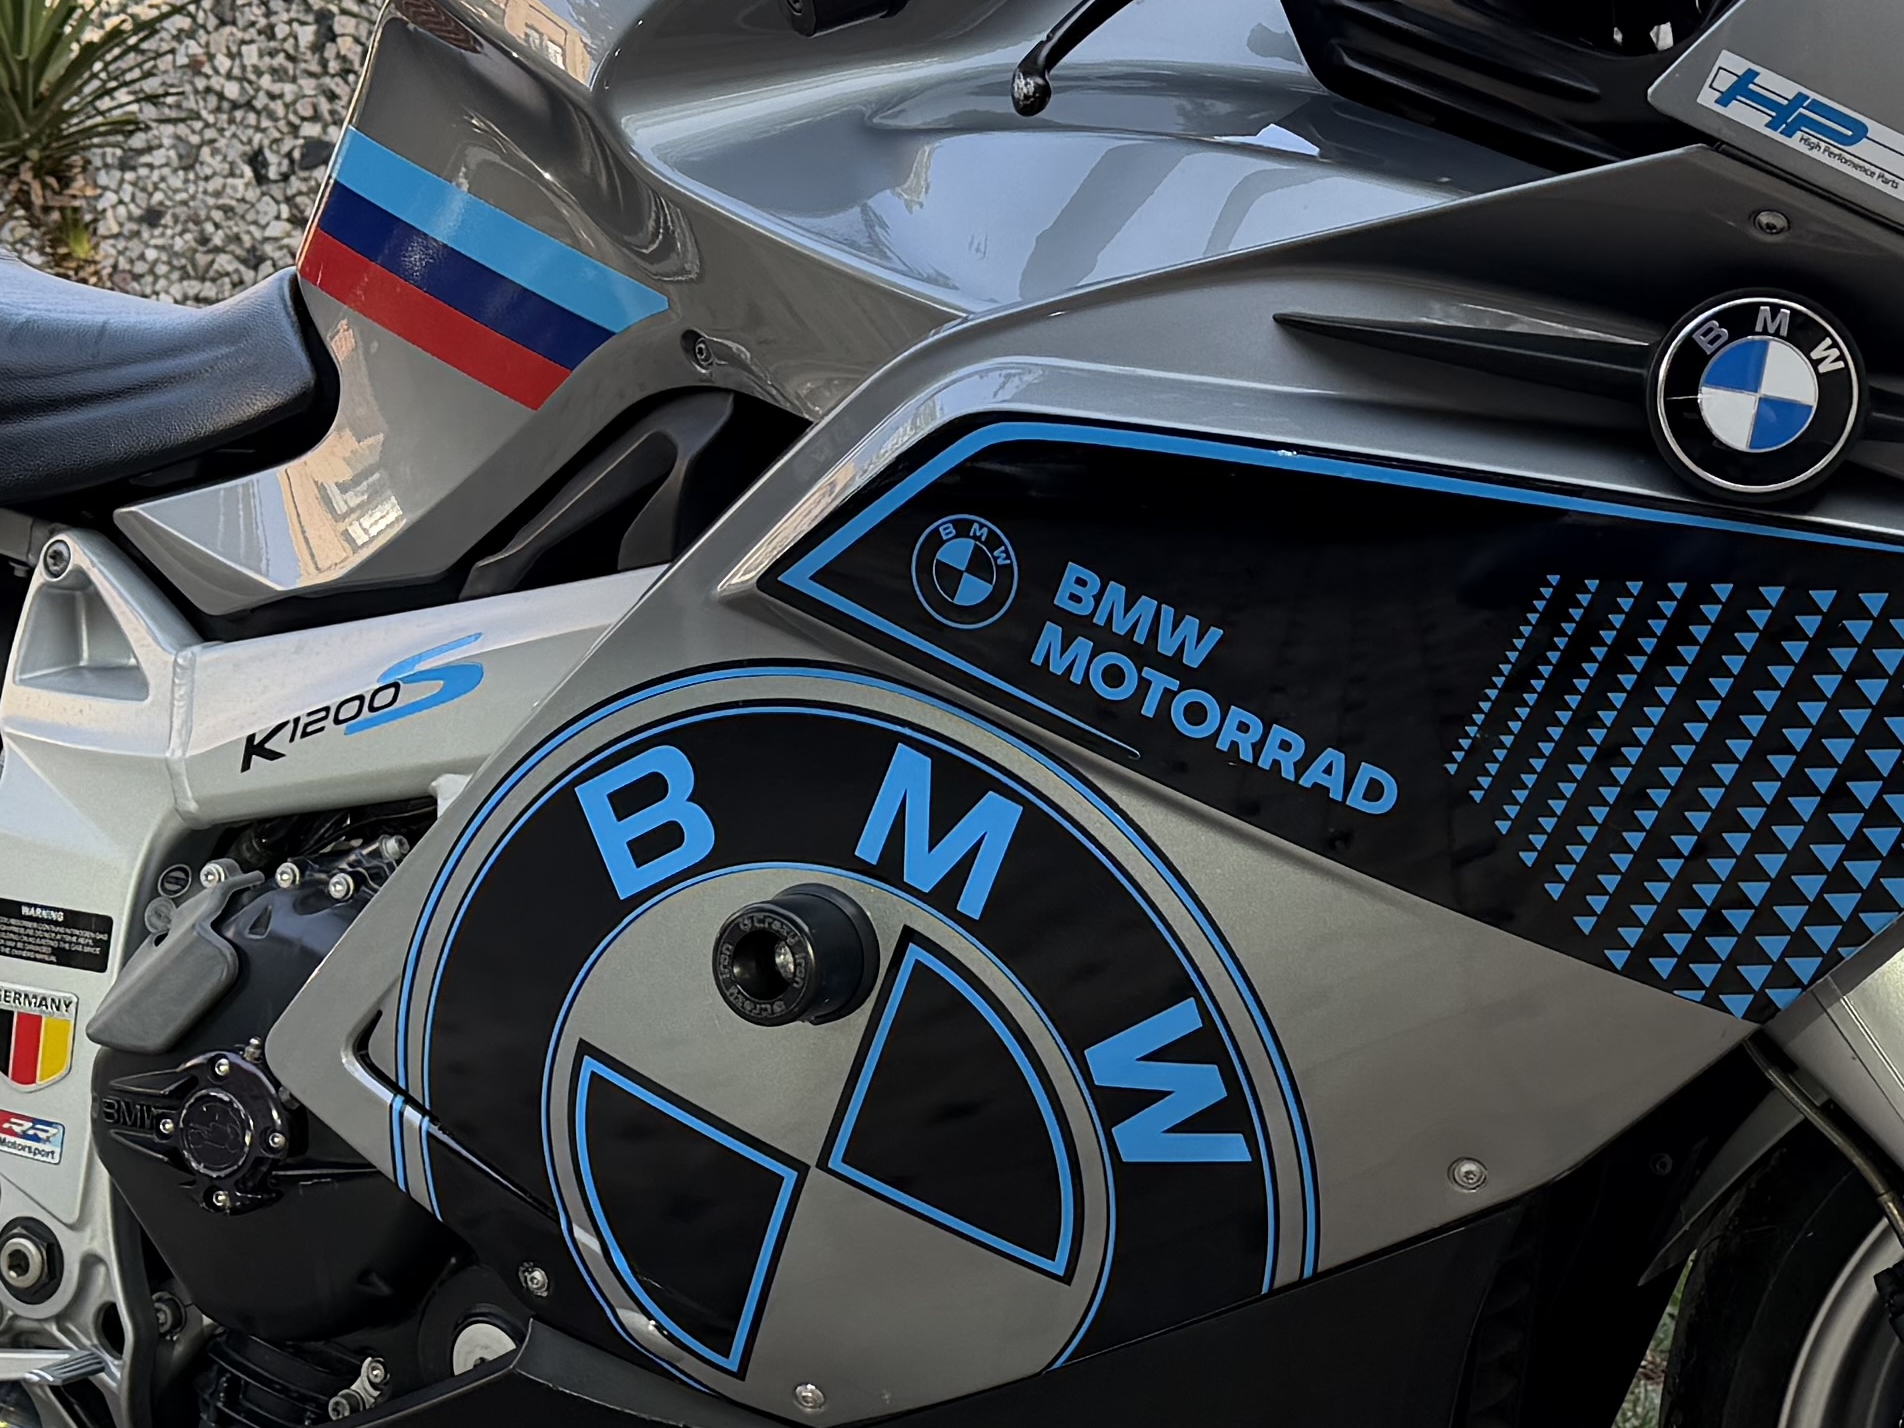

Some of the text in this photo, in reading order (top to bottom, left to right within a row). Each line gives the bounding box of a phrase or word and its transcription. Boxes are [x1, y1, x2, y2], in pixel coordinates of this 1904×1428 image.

[1714, 67, 1869, 147] HP
[1798, 134, 1822, 154] High
[1877, 171, 1900, 190] Parts
[1693, 306, 1845, 375] BMW
[939, 522, 1011, 566] BMW
[1053, 561, 1224, 669] BMW
[240, 632, 485, 773] K1200S
[1030, 620, 1398, 815] MOTORRAD
[576, 742, 1252, 1163] BMW
[2, 1117, 59, 1144] RR
